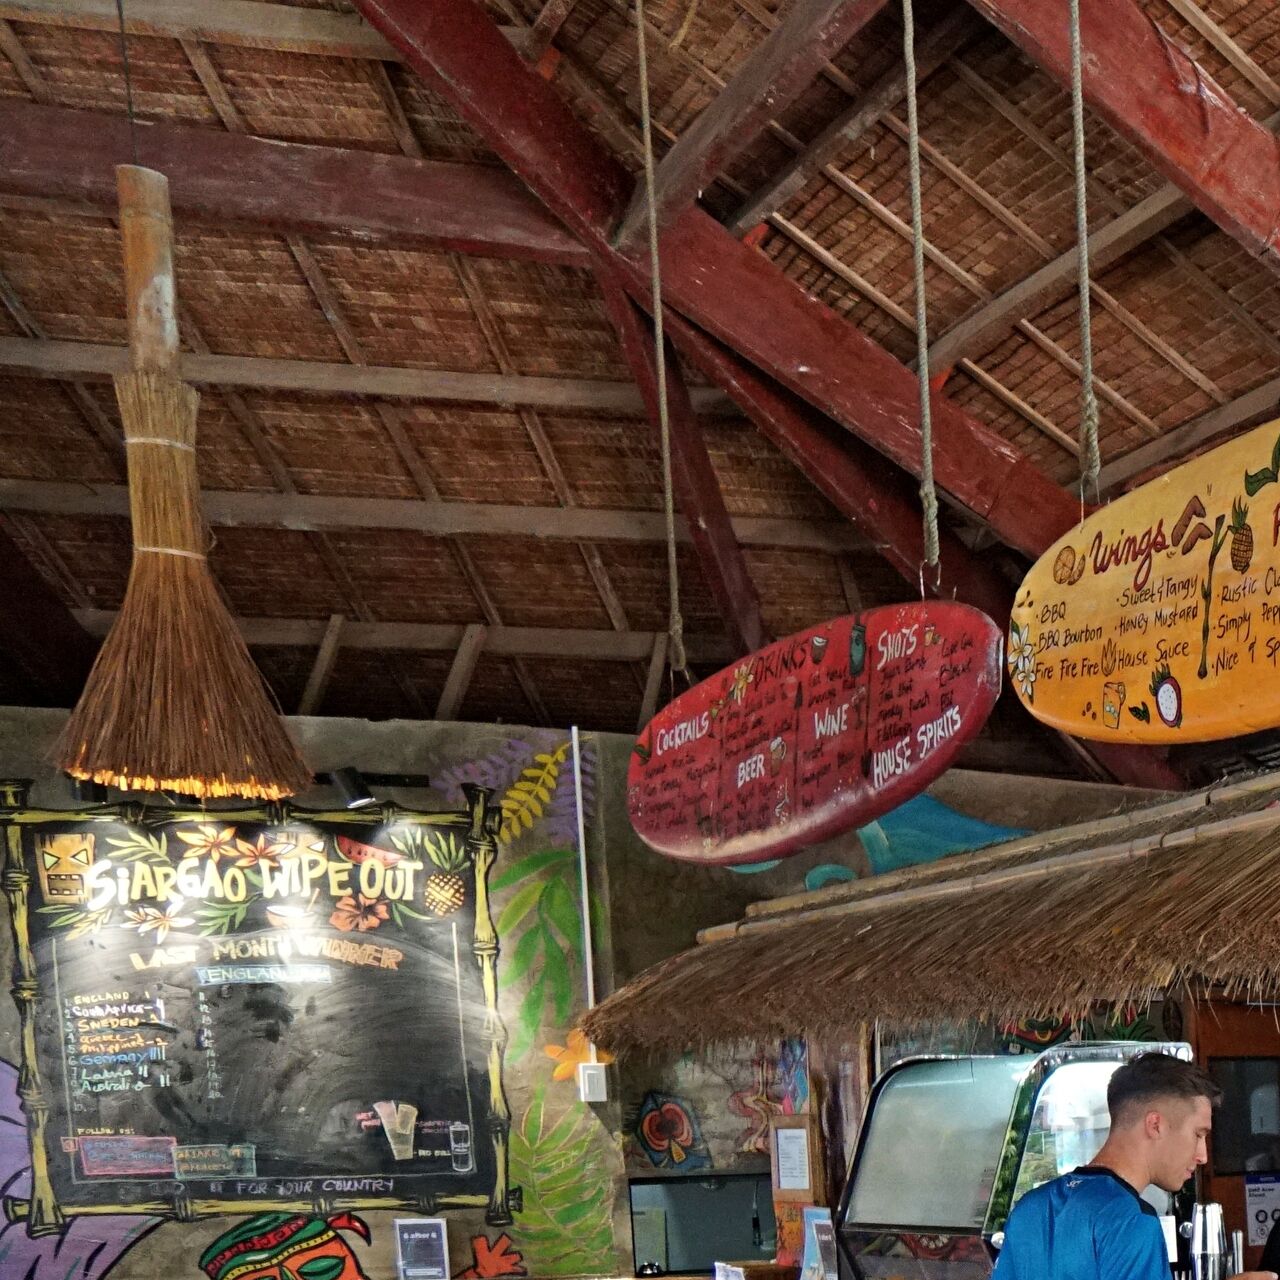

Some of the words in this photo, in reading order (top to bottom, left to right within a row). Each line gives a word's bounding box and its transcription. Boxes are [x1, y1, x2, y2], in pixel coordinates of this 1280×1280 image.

[1089, 518, 1170, 591] Wings
[1166, 574, 1198, 599] Tangy
[1041, 601, 1066, 624] BBQ
[1217, 609, 1251, 642] Simply
[877, 624, 919, 671] SHOTS
[1036, 629, 1059, 654] BBQ
[1063, 624, 1102, 648] Bourbon
[1118, 649, 1148, 671] House
[1155, 639, 1190, 663] Sauce
[1036, 662, 1053, 680] Fire
[1060, 659, 1077, 680] Fire
[1081, 657, 1099, 678] Fire
[1215, 650, 1239, 676] Nice
[814, 703, 849, 740] WINE
[873, 736, 912, 788] HOUSE
[917, 705, 962, 759] SPIRITS
[737, 754, 765, 789] BEER
[258, 855, 353, 899] WIPE
[359, 858, 423, 901] OUT
[237, 1182, 267, 1195] FOR
